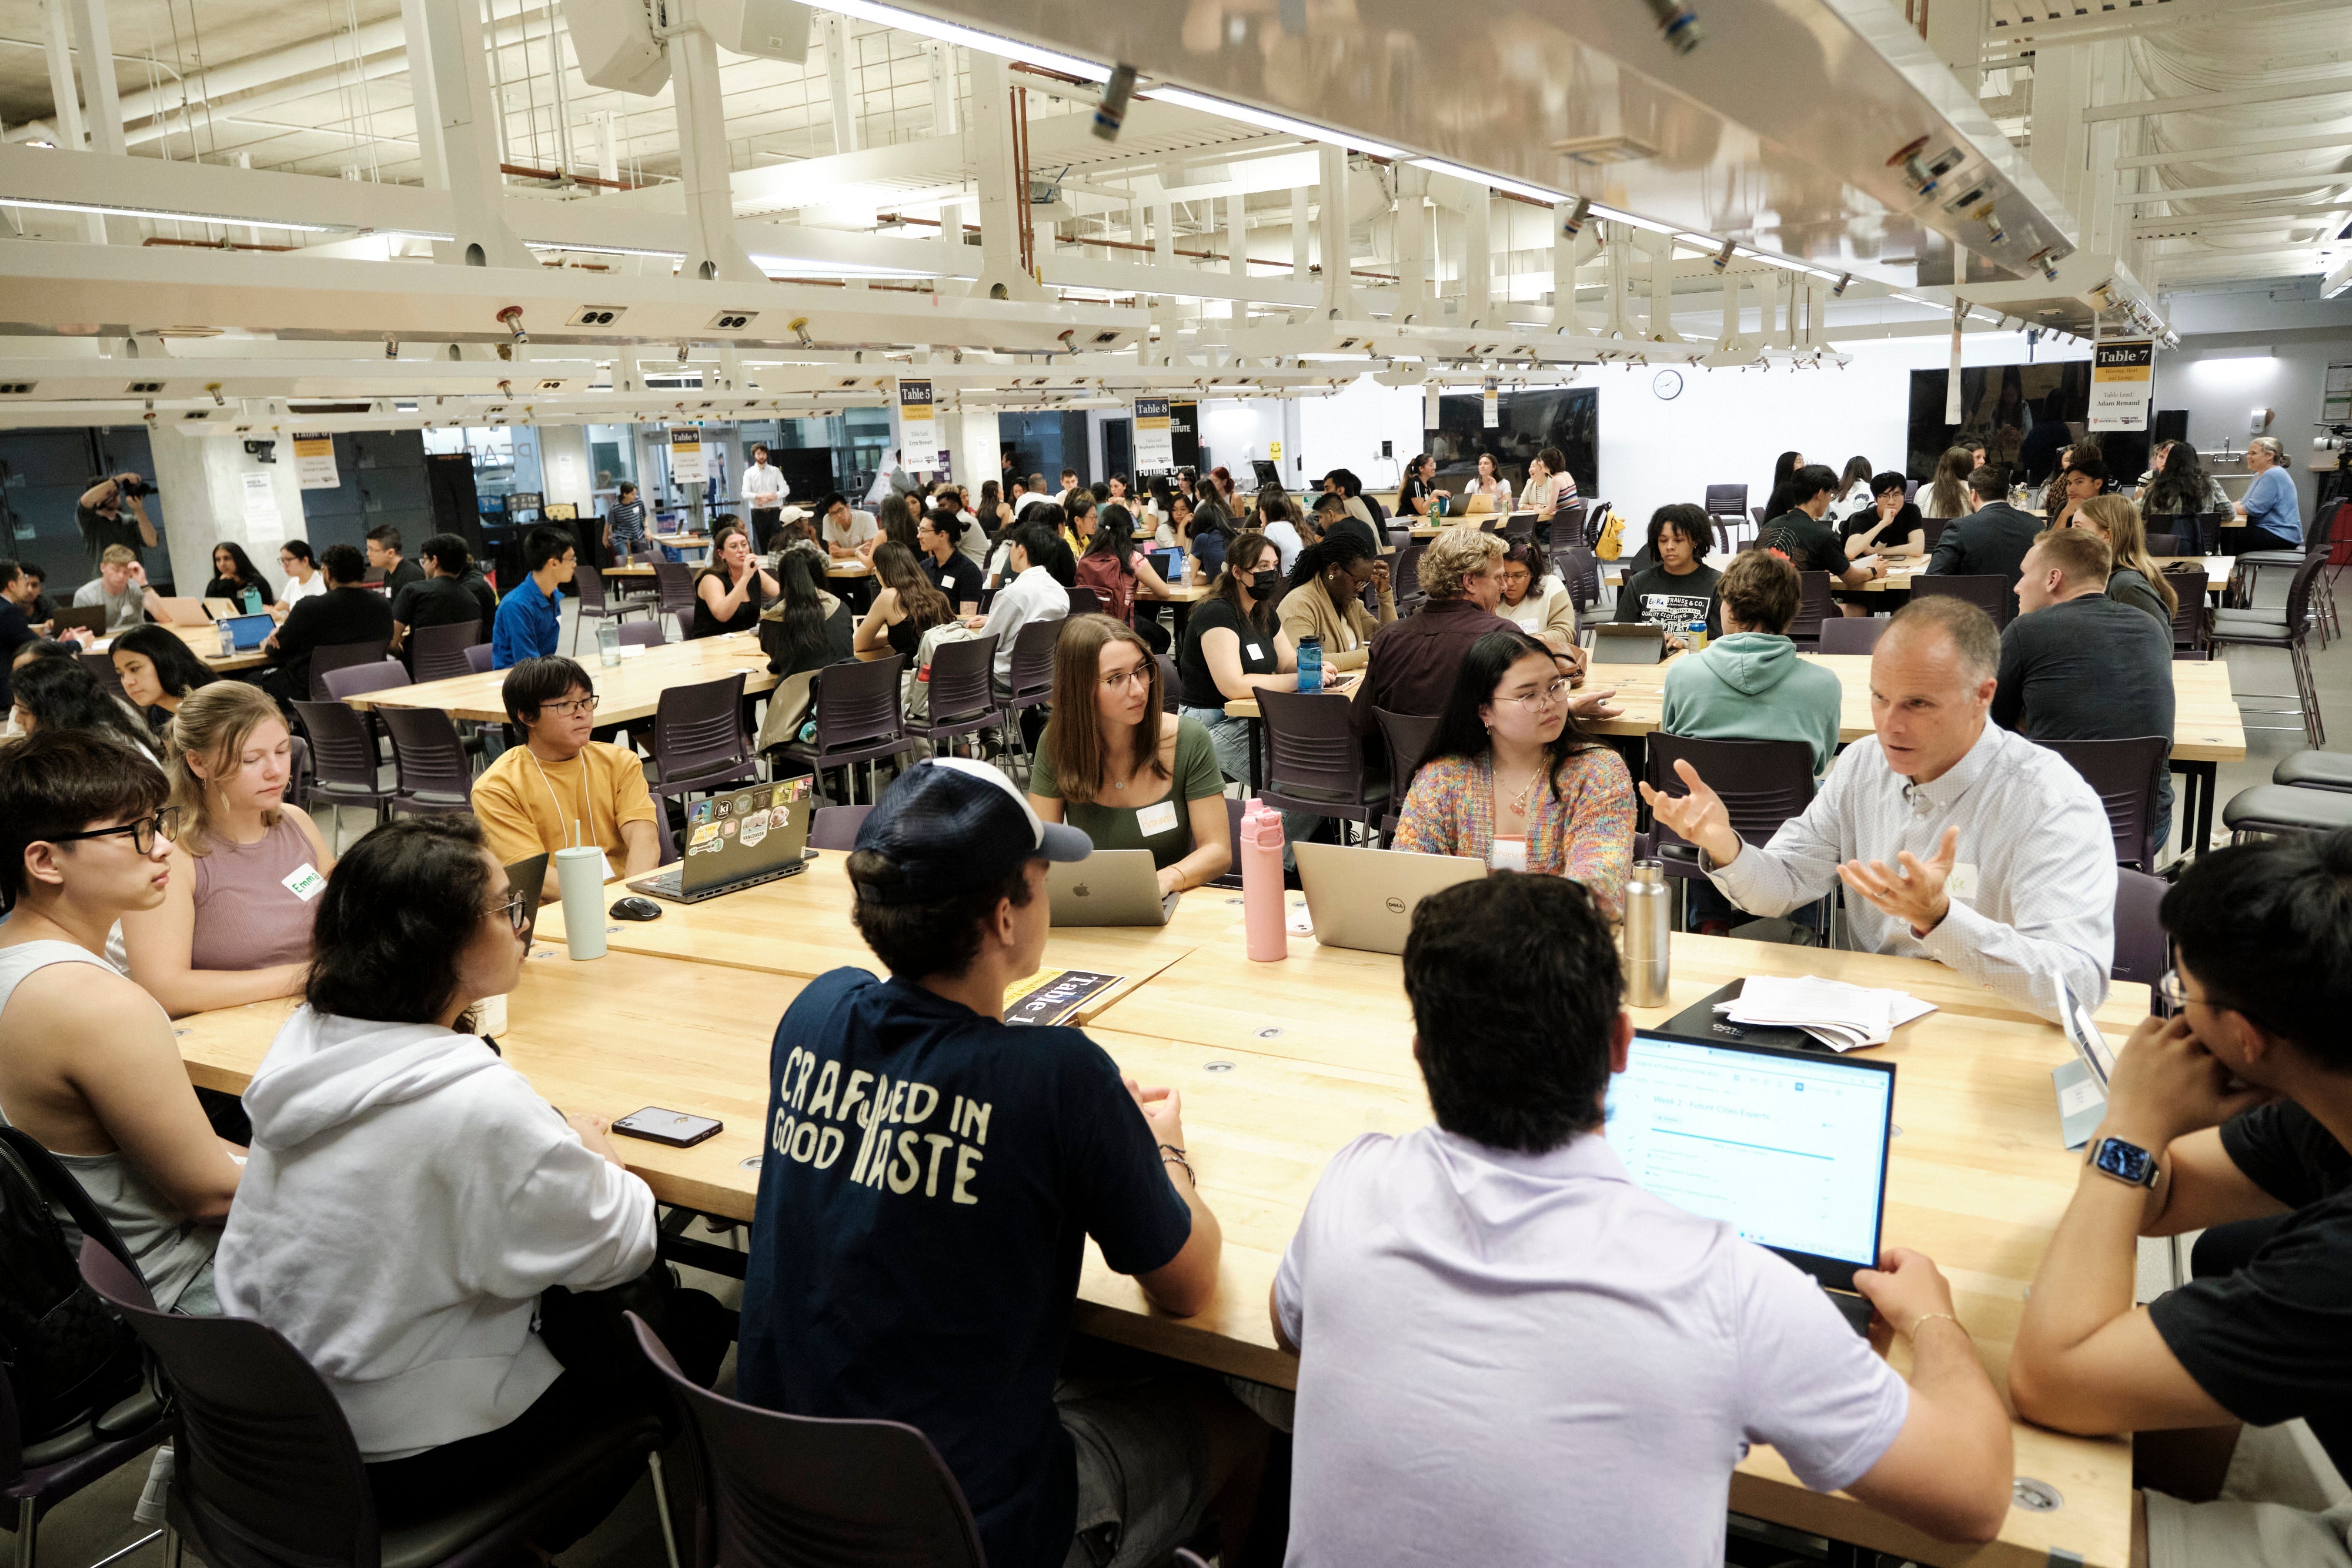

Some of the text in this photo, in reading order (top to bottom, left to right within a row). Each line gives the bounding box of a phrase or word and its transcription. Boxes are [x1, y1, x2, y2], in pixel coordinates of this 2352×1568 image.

[2099, 350, 2149, 362] Table 7
[902, 388, 930, 400] Table 5
[1137, 404, 1167, 414] Table 8
[673, 433, 692, 442] Table
[1170, 465, 1195, 476] CIS
[1140, 814, 1175, 828] Hannah
[743, 831, 764, 841] VANCOUVER
[291, 872, 320, 893] Emma
[1020, 971, 1060, 992] Renewable
[1025, 976, 1099, 1011] Table
[1654, 1095, 1675, 1105] Week
[1689, 1101, 1715, 1111] Future
[1716, 1106, 1738, 1115] Cities
[1740, 1109, 1770, 1121] Experts
[949, 1095, 993, 1146] IN
[772, 1107, 845, 1169] GOOD
